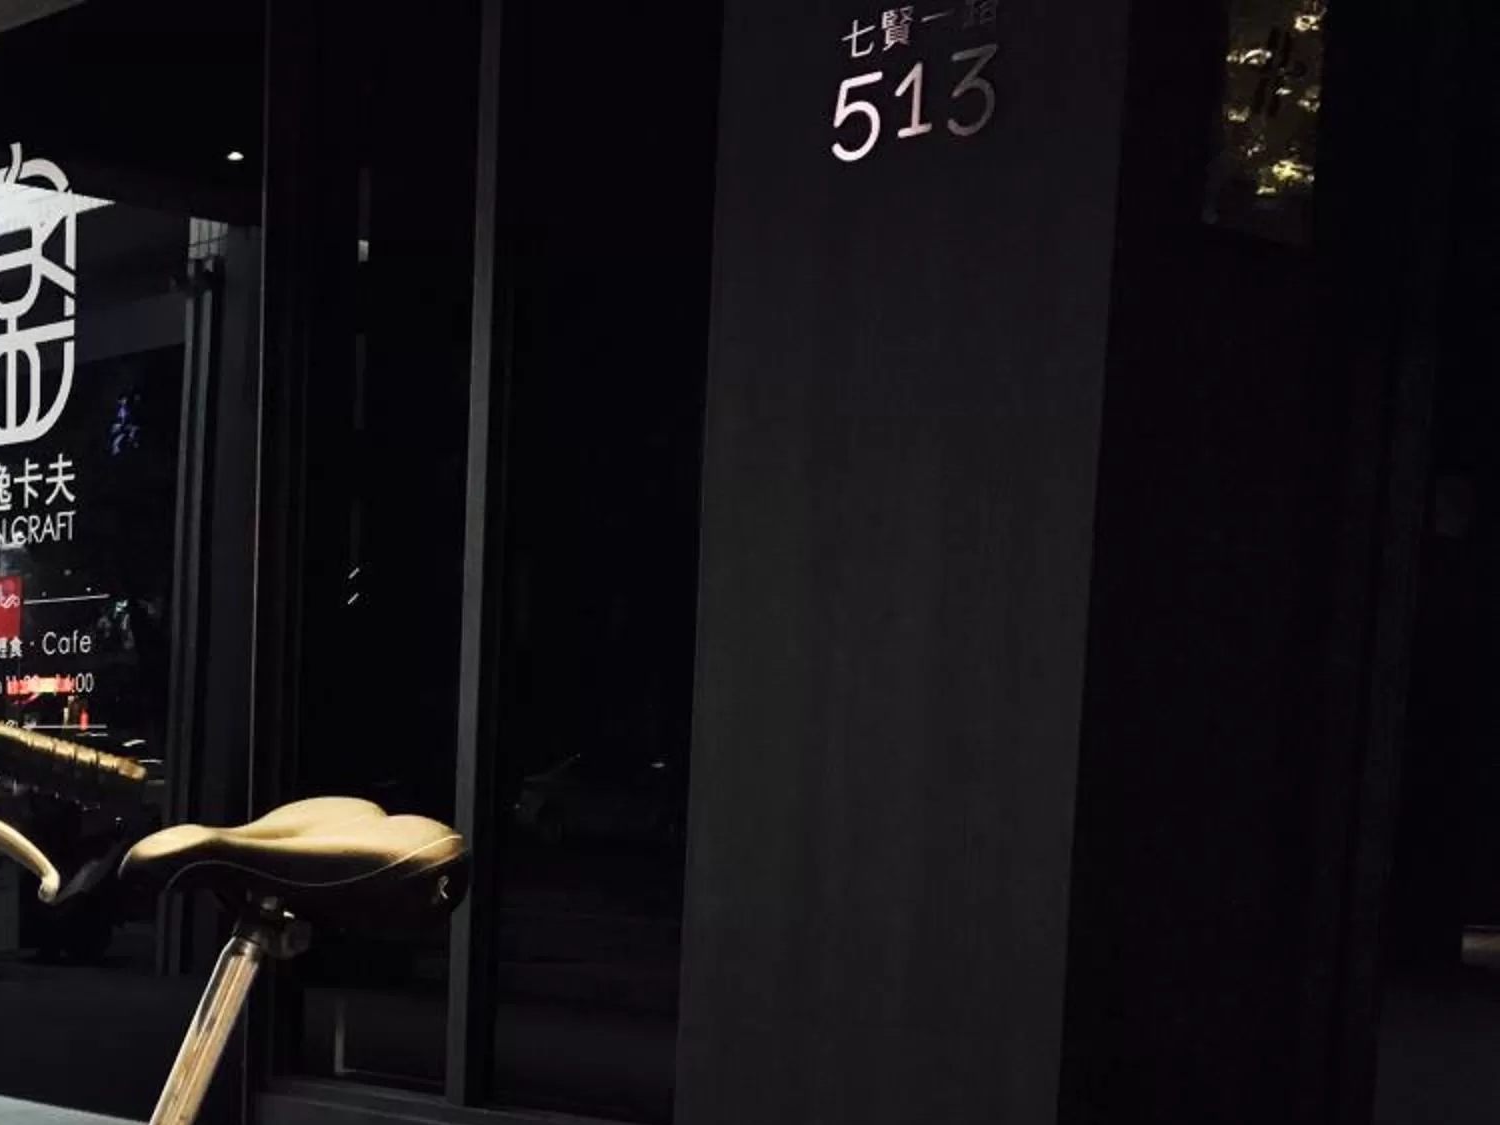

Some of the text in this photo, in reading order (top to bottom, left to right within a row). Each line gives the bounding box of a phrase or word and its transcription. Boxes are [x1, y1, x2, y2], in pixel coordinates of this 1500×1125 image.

[831, 43, 998, 162] 513
[11, 511, 76, 545] CRAFT
[42, 630, 92, 655] Cafe
